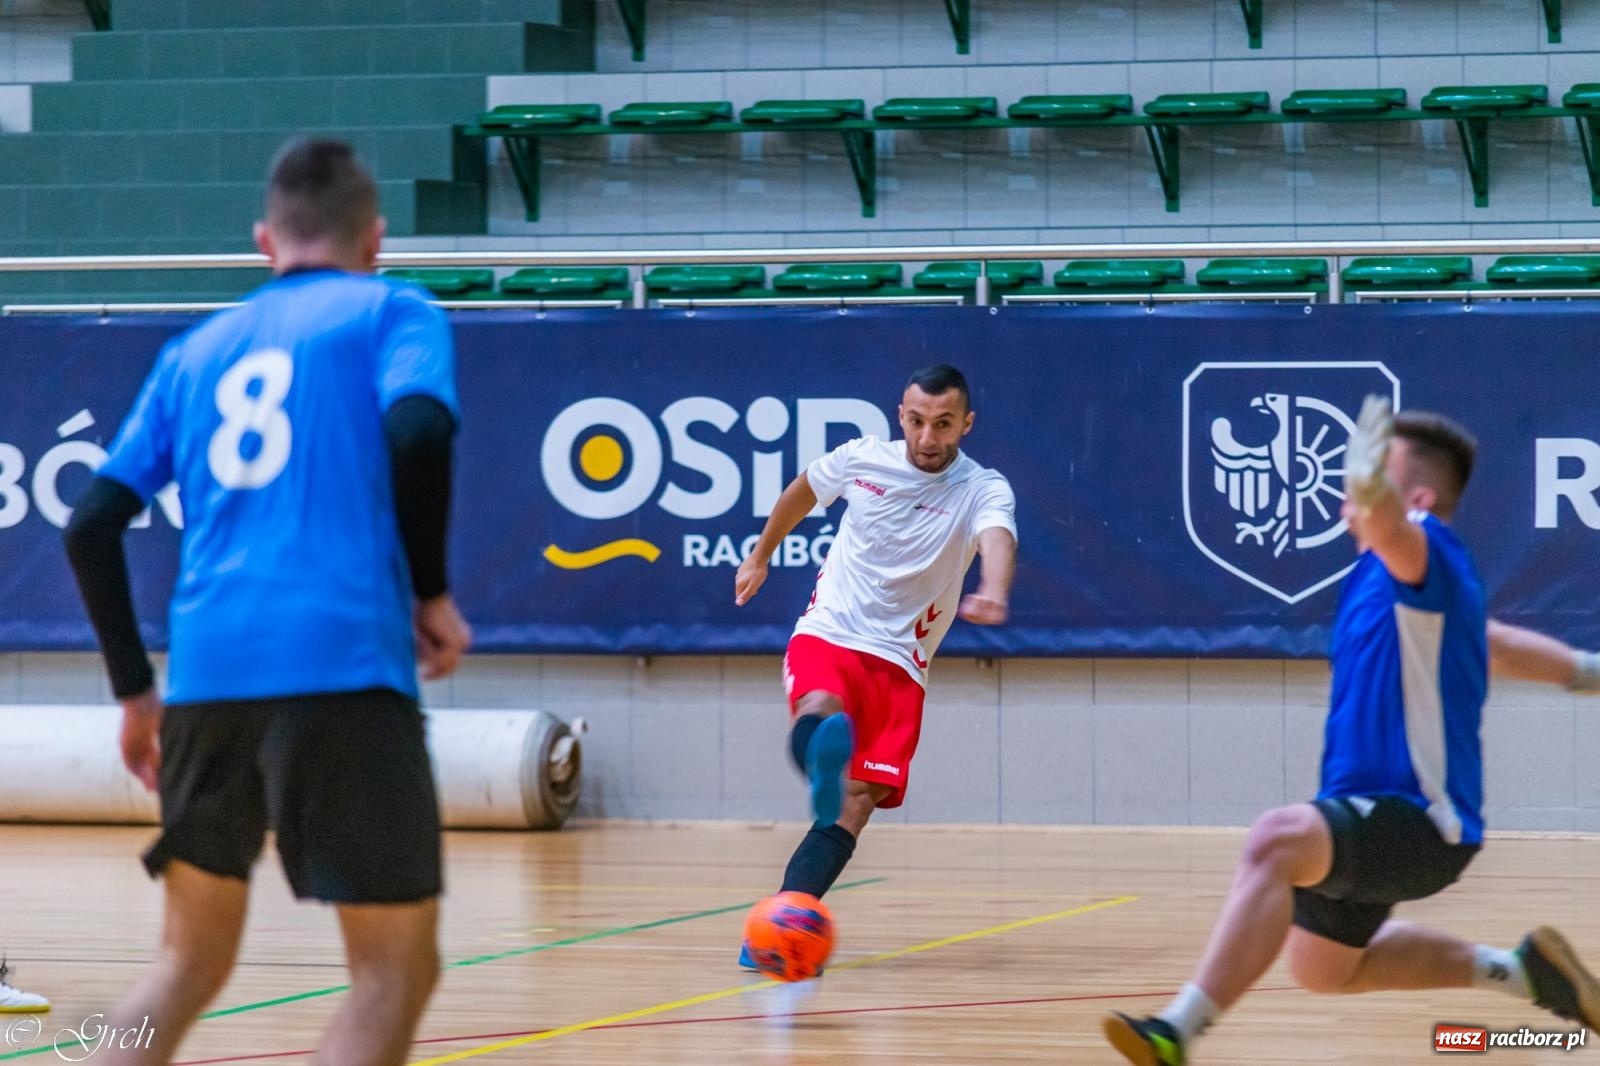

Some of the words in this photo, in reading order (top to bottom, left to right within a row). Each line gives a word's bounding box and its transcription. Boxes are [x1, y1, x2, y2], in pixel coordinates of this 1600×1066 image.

[207, 347, 293, 490] 8
[855, 478, 887, 497] hummel
[863, 759, 900, 777] hummel
